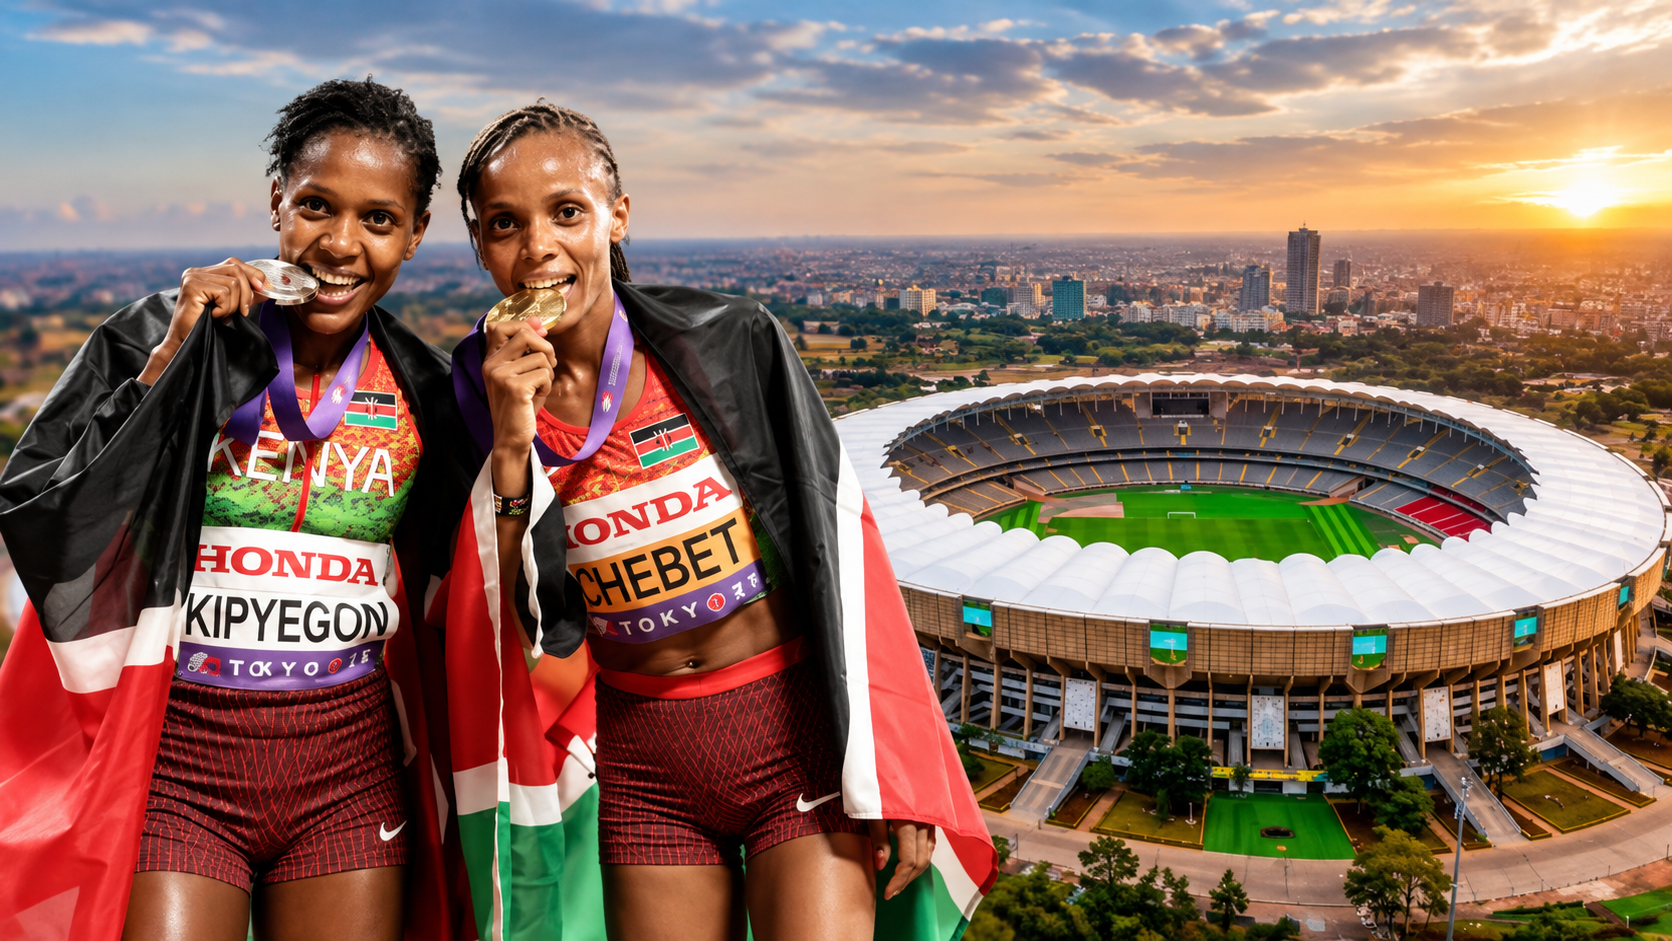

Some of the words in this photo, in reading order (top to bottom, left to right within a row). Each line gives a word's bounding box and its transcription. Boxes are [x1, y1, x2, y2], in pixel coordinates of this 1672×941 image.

[207, 430, 395, 497] KENYA
[194, 544, 378, 587] HONDA
[576, 517, 739, 607] CHEBET
[185, 593, 389, 643] KIPYEGON
[229, 659, 319, 677] TOKYO
